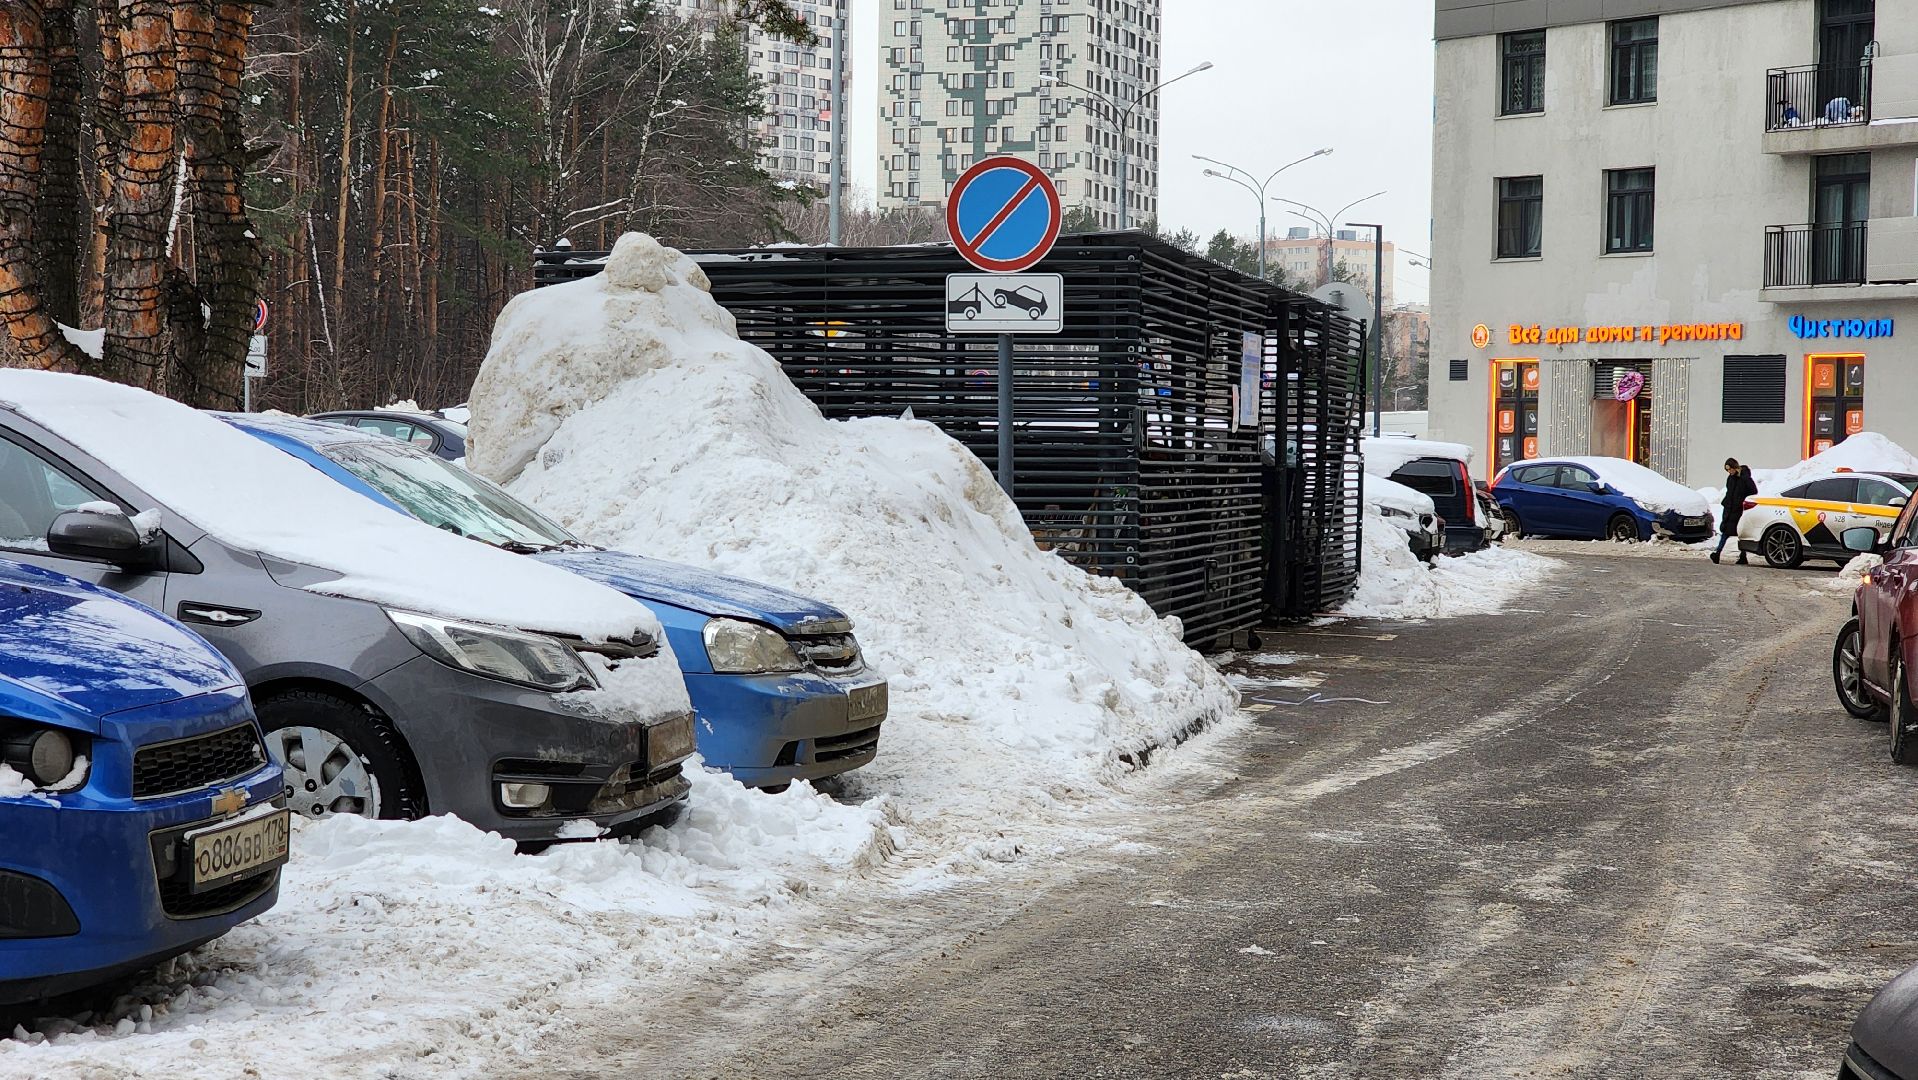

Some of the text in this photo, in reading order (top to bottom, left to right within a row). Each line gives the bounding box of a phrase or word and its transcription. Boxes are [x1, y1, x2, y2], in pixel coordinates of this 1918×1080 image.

[1509, 322, 1743, 346] Всё для дома и ремонта
[1788, 315, 1894, 339] Чистюля
[1875, 519, 1894, 529] Яндек
[265, 817, 284, 846] 178
